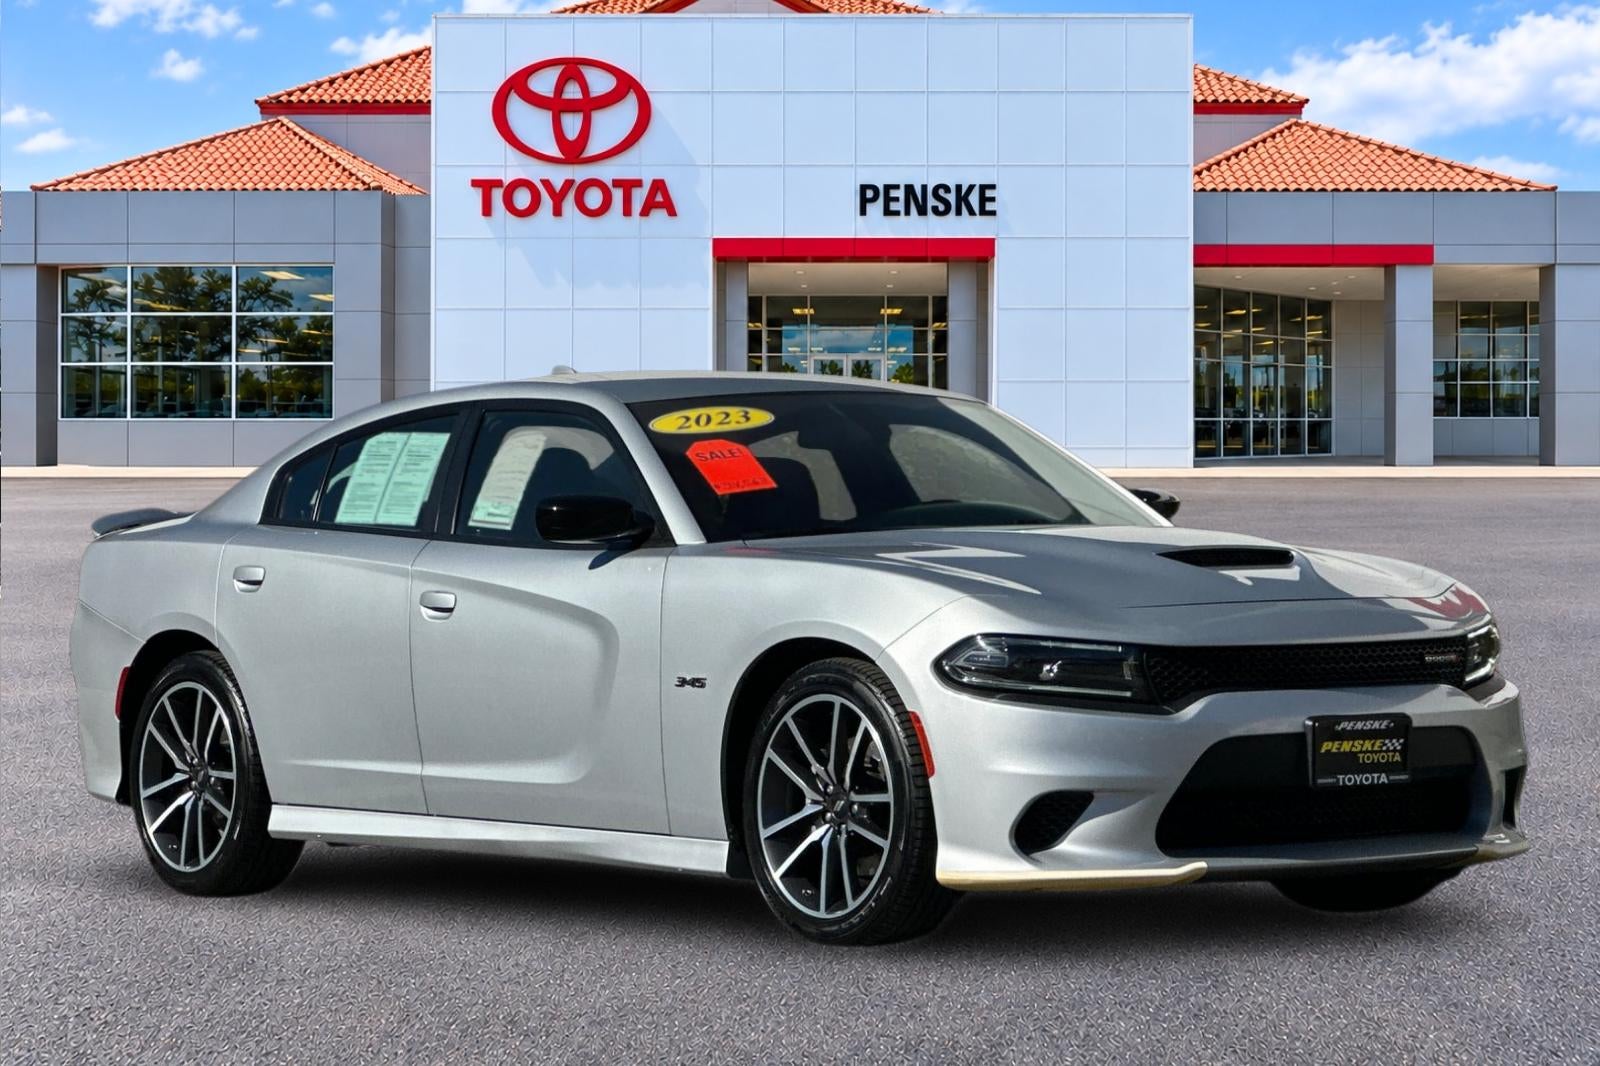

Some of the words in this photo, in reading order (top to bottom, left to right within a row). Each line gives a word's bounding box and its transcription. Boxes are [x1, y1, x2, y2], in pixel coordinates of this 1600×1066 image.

[471, 178, 677, 217] TOYOTA
[859, 183, 997, 217] PENSKE
[675, 410, 751, 430] 2023
[674, 676, 707, 689] 345
[1337, 720, 1390, 730] PENSKE
[1320, 739, 1384, 753] PENSKE
[1358, 752, 1401, 764] TOYOTA
[1337, 773, 1388, 786] TOYOTA
